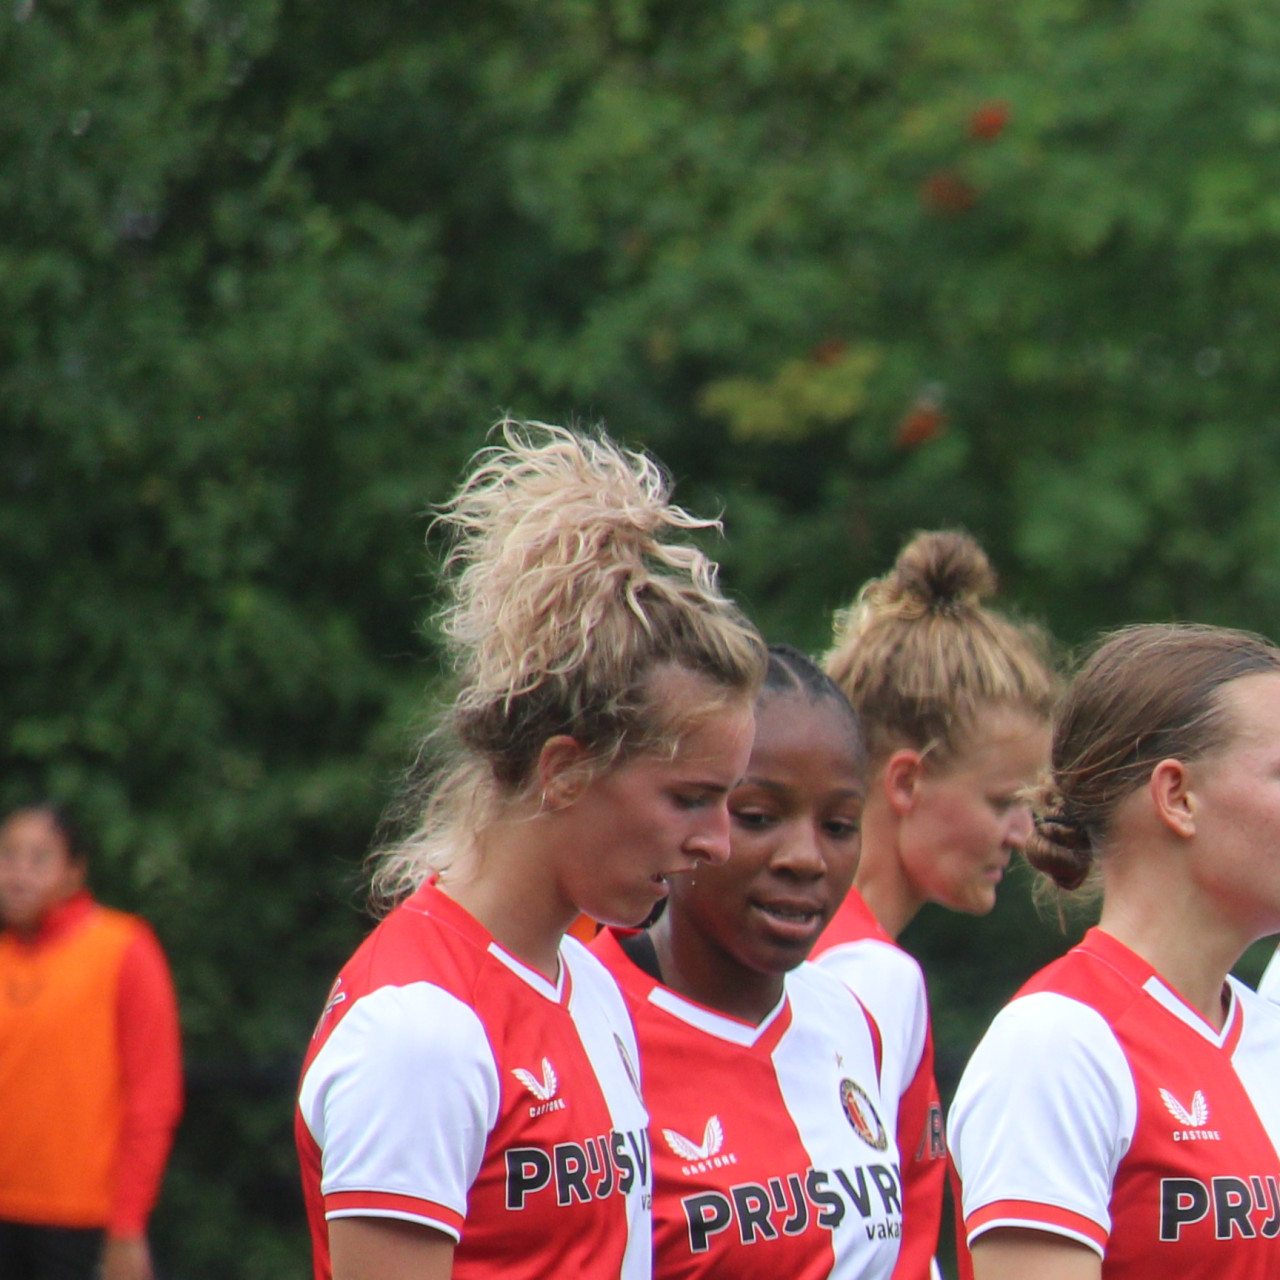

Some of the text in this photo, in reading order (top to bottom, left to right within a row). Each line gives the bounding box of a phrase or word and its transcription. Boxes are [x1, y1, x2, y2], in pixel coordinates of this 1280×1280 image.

[1173, 1130, 1221, 1141] CASTORE
[505, 1128, 651, 1211] PRIJSV
[681, 1153, 737, 1177] CASTORE
[681, 1162, 901, 1253] PRIJSVR
